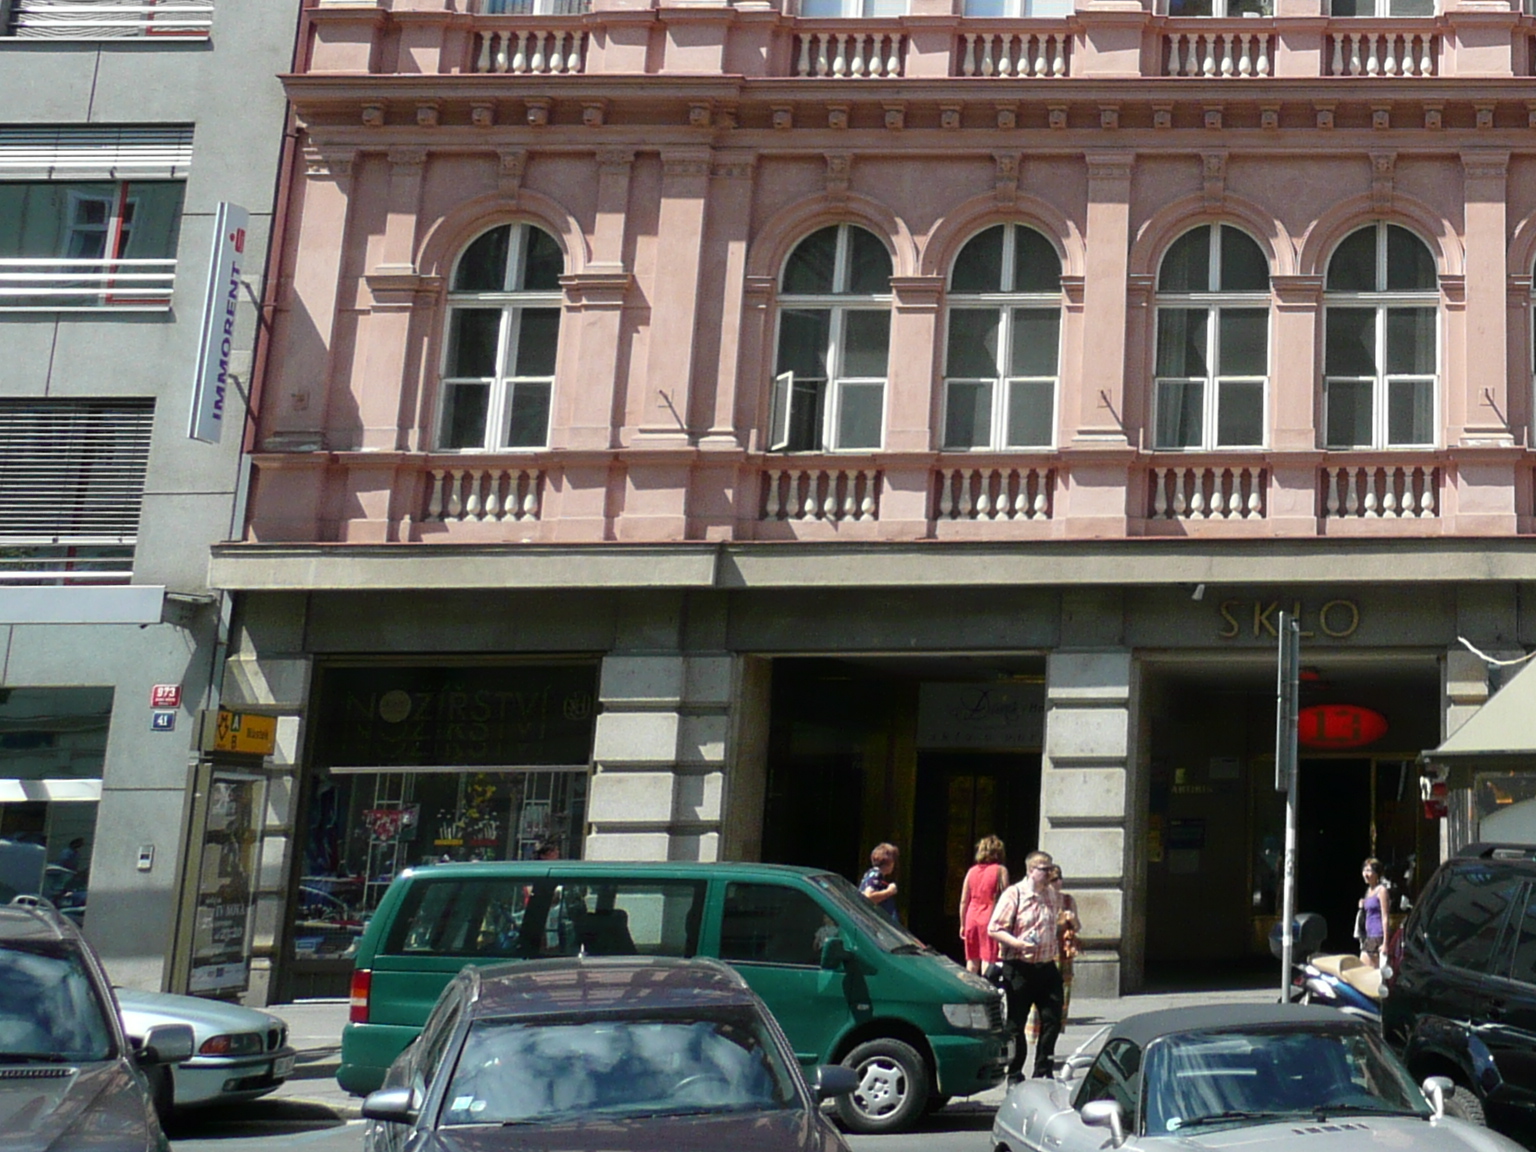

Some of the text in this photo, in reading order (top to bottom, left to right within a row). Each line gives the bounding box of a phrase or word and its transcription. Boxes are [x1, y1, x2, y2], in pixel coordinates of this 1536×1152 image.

[212, 261, 241, 421] IMMORENT
[1219, 599, 1360, 638] SKLO
[157, 687, 177, 698] 973
[157, 714, 169, 726] 41
[232, 714, 239, 730] A
